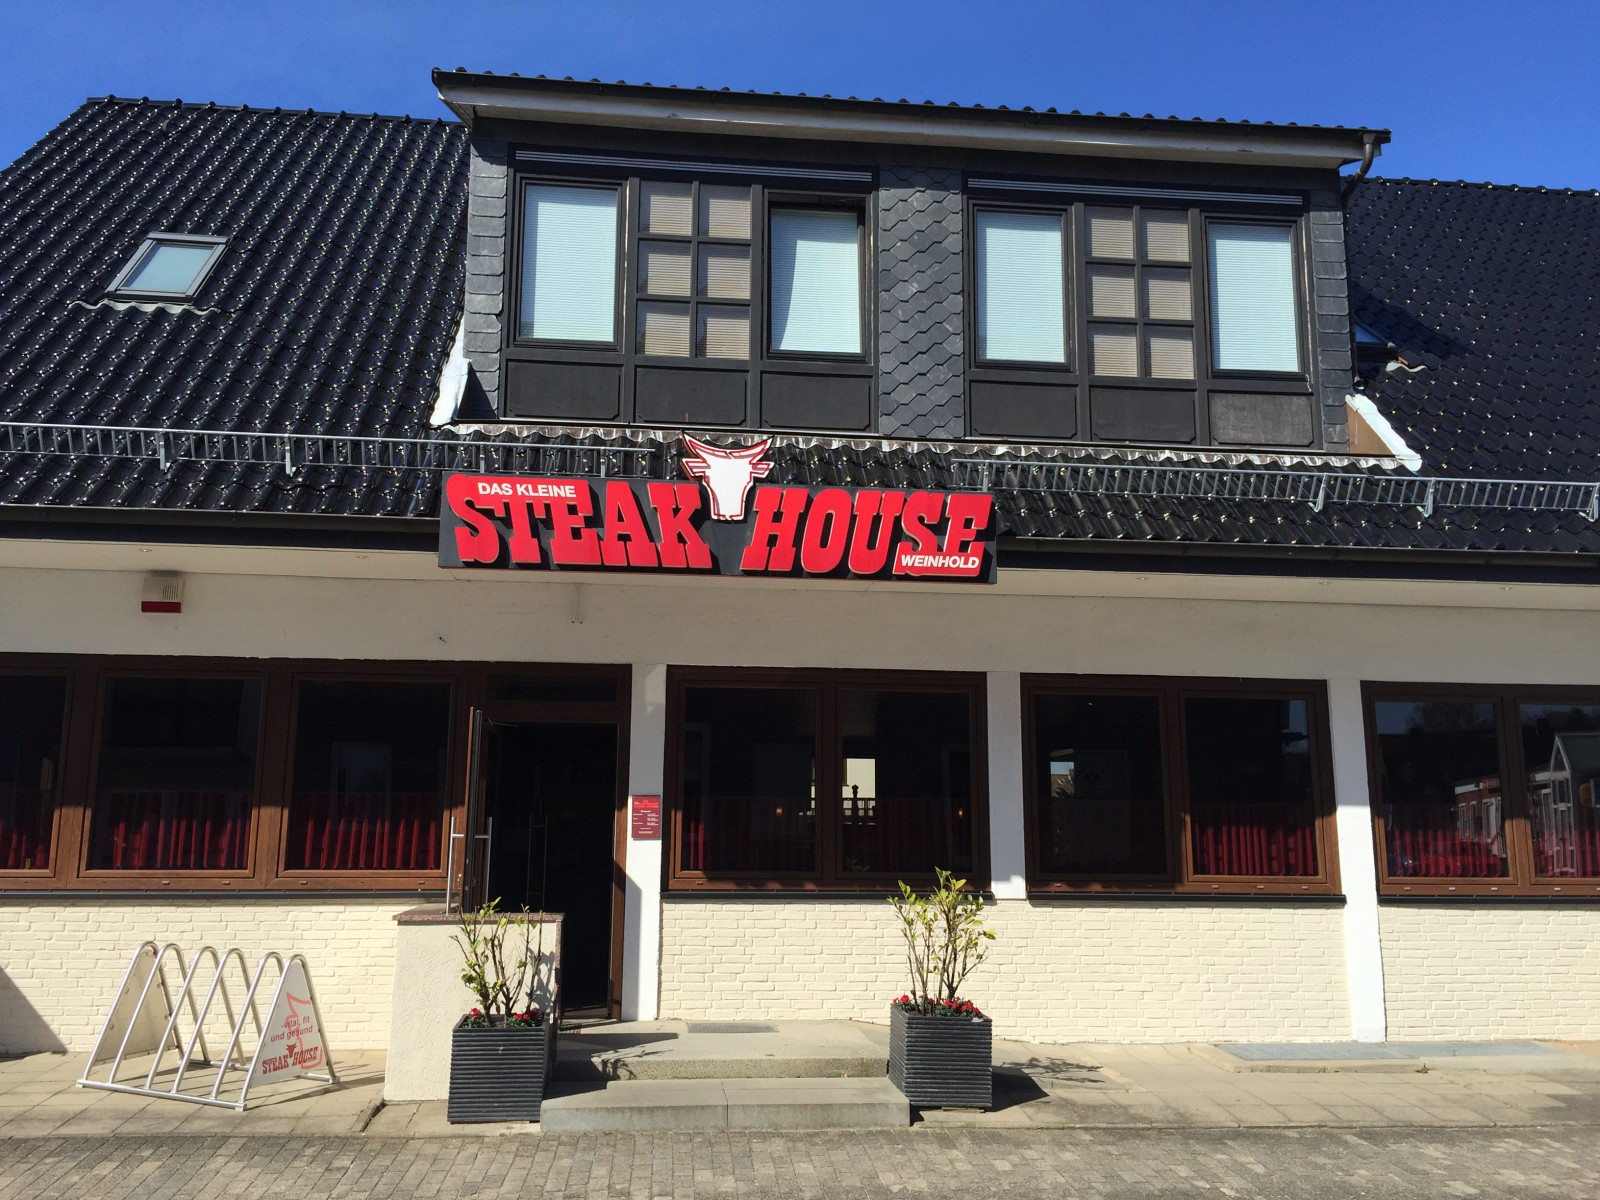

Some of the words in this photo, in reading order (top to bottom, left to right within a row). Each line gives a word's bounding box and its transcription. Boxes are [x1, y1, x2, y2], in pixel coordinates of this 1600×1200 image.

[478, 482, 513, 495] DAS
[516, 483, 577, 498] KLEINE
[446, 473, 712, 568] STEAK
[741, 487, 991, 577] HOUSE
[901, 554, 980, 569] WEINHOLD
[271, 1032, 284, 1042] und
[287, 1025, 312, 1040] gesund
[262, 1054, 289, 1075] STEAK
[292, 1046, 318, 1066] HOUSE
